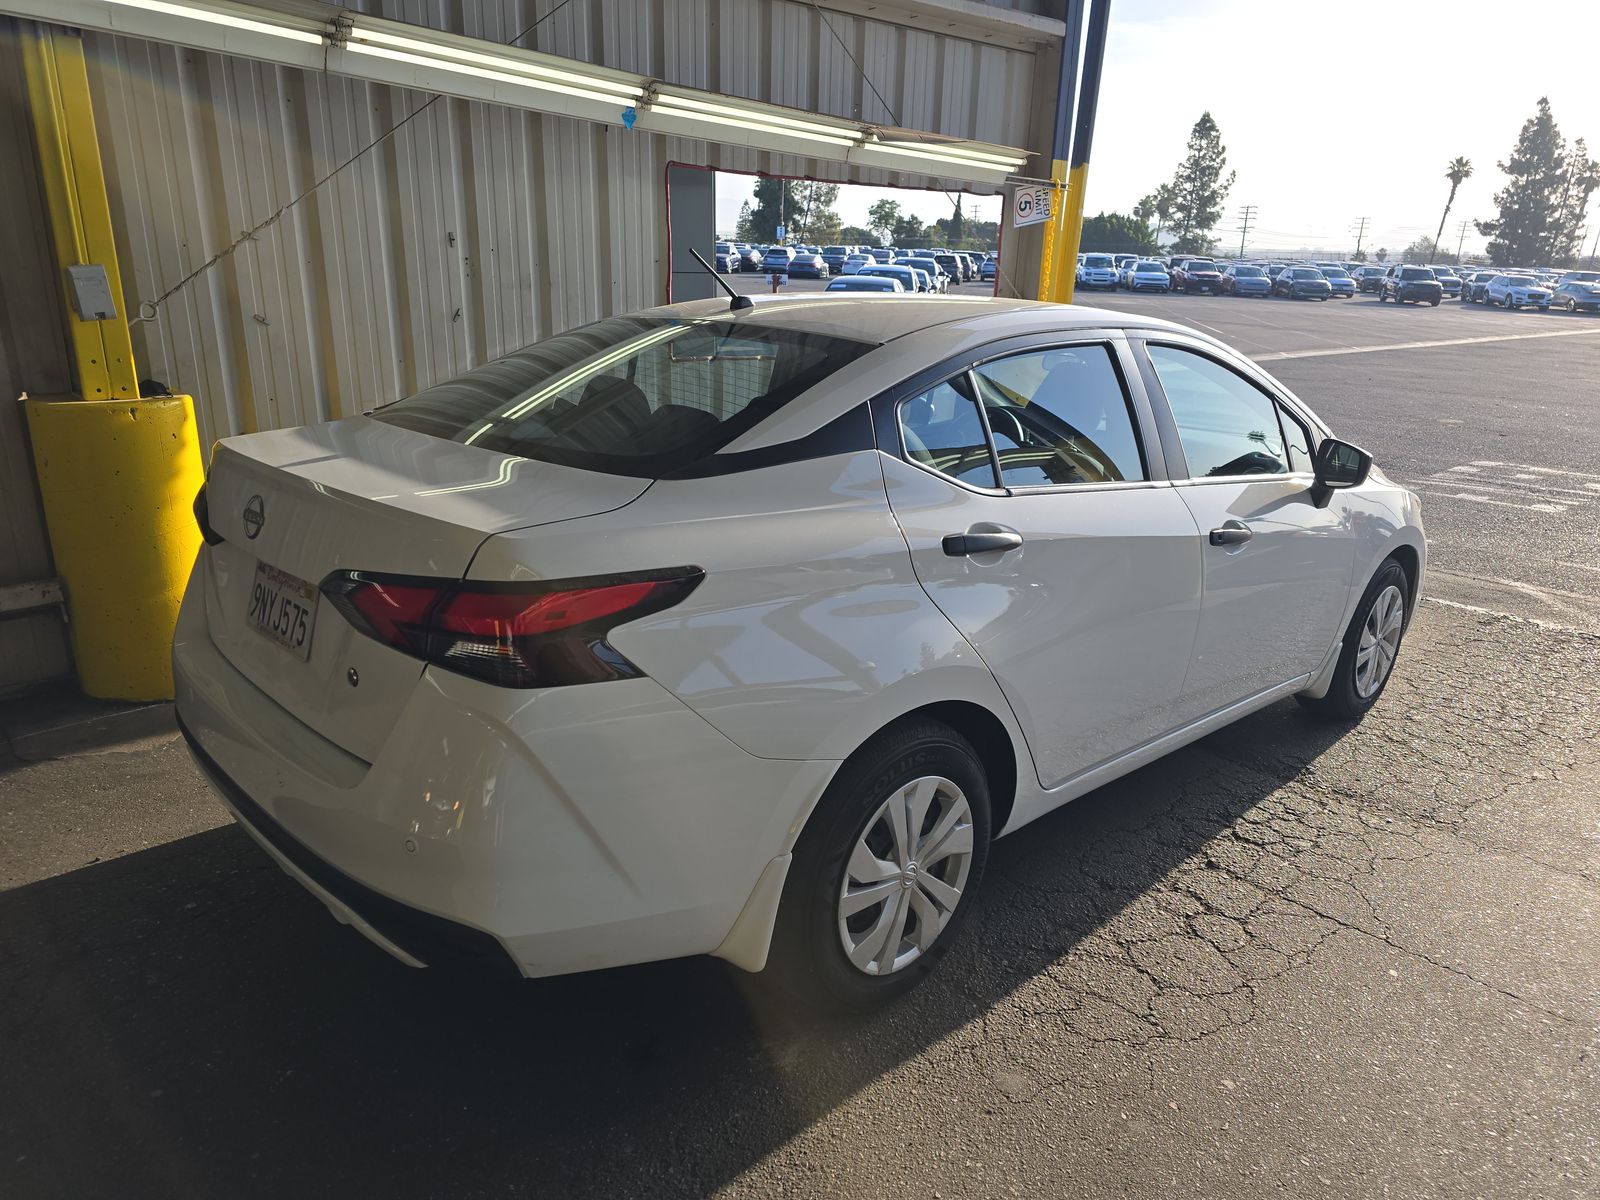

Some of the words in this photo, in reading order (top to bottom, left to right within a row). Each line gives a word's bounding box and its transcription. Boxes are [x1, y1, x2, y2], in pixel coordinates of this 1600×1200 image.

[1018, 200, 1032, 212] 5
[1034, 190, 1043, 216] LIMIT
[250, 582, 309, 646] 9NYJ575
